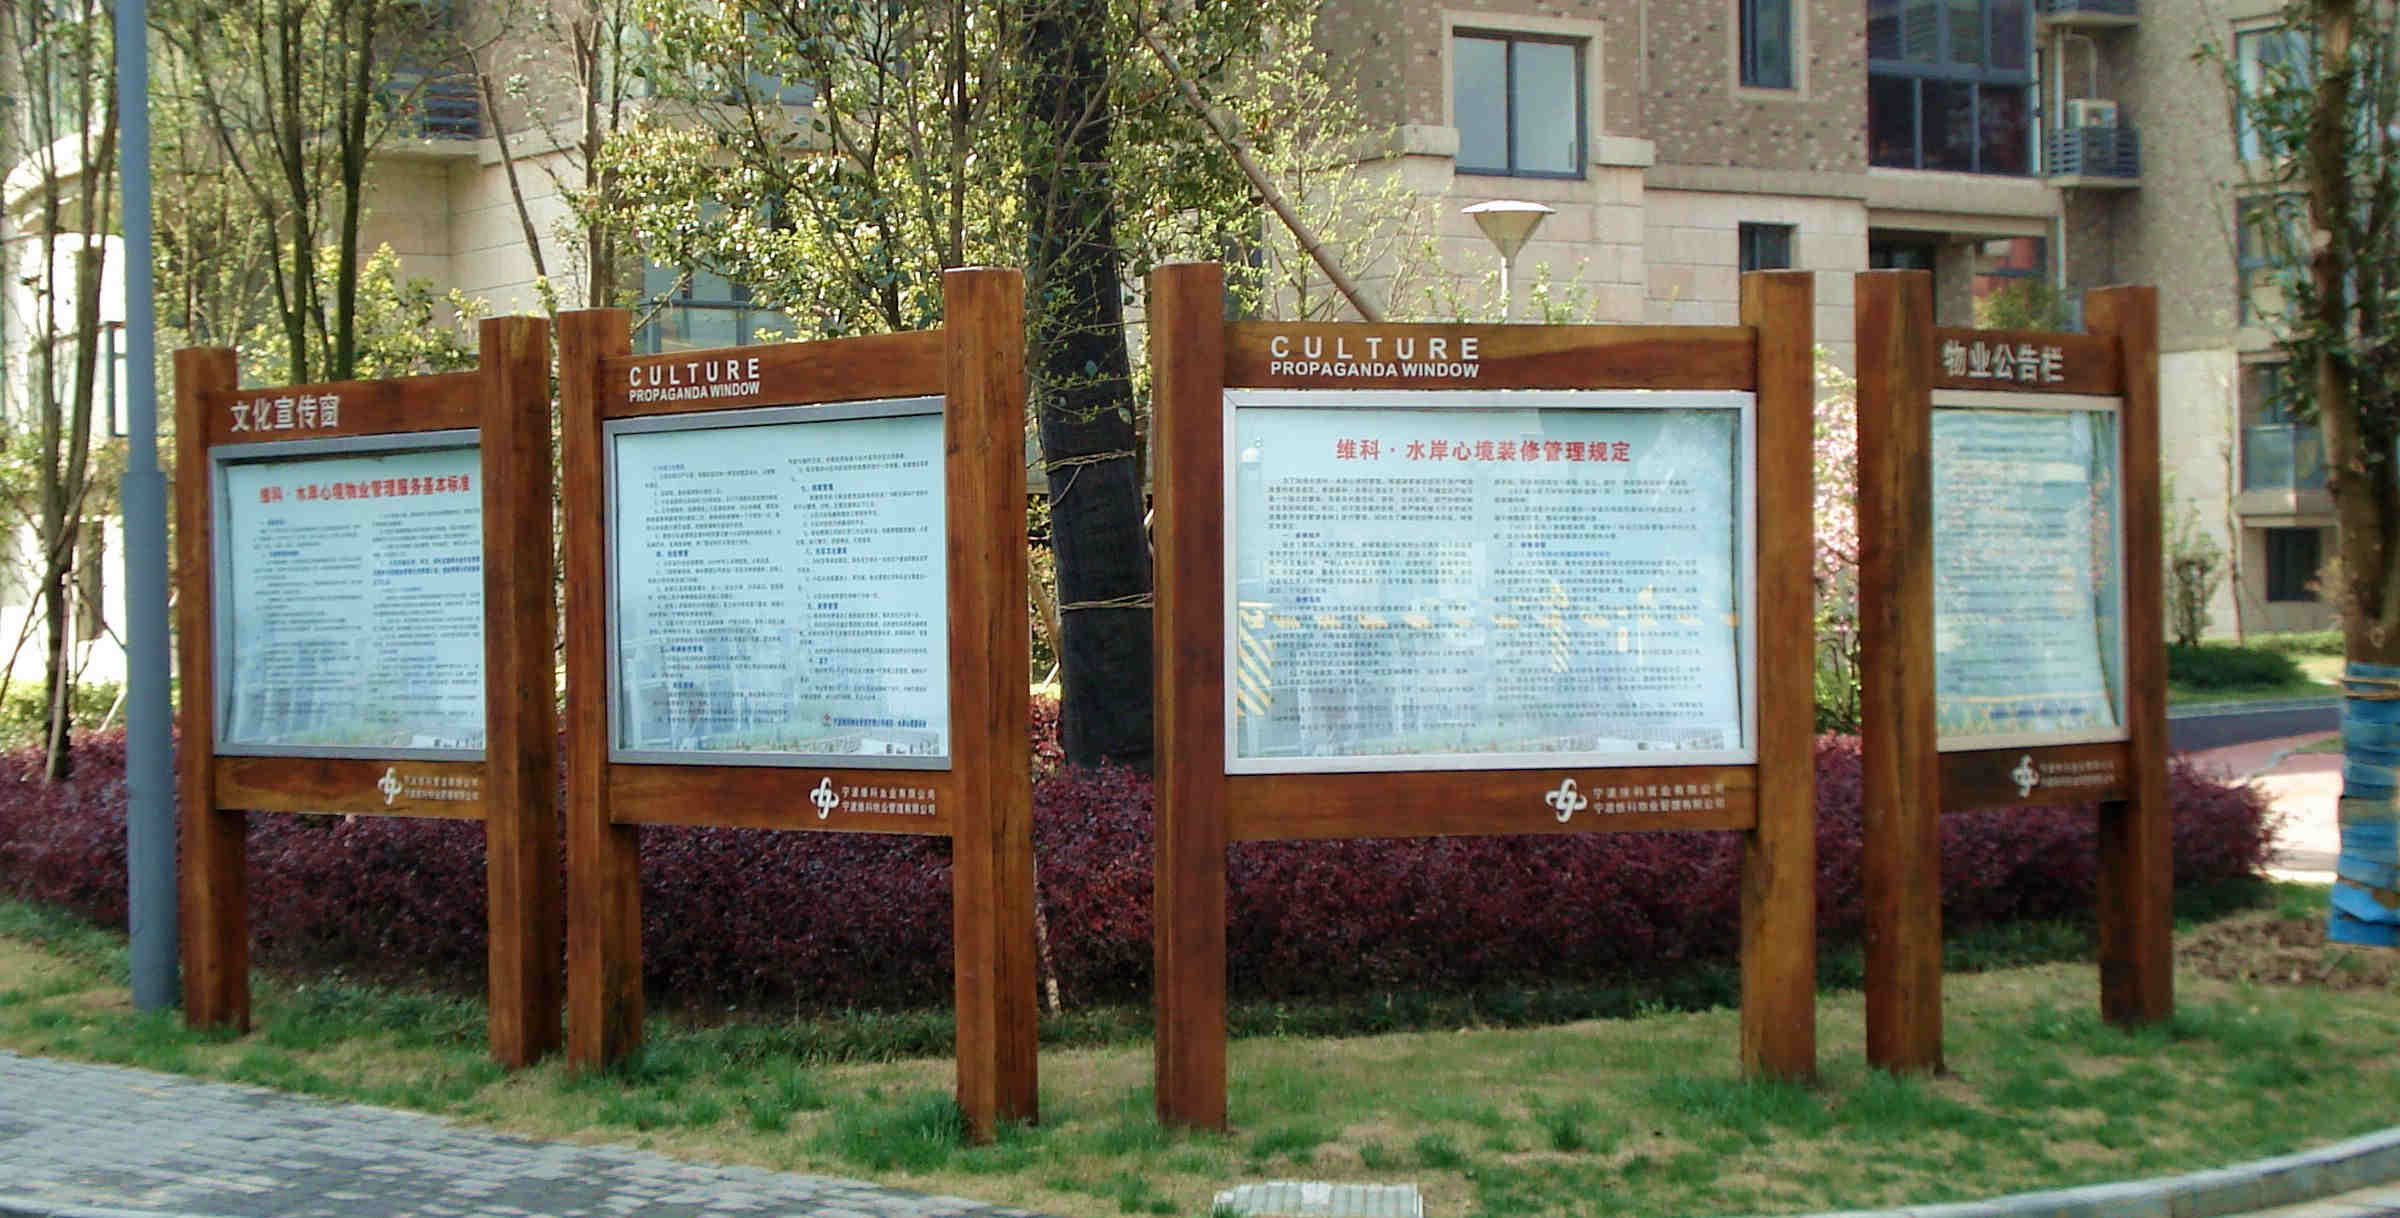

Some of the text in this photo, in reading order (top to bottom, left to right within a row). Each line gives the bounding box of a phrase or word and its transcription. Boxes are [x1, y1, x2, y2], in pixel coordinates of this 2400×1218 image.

[1271, 335, 1480, 360] CULTURE
[1942, 339, 2066, 382] 物业公告栏
[628, 357, 761, 387] CULTURE
[1271, 360, 1480, 378] PROPAGANDA WINDOW
[628, 380, 761, 403] PROPAGANDA WINDOW
[230, 393, 340, 433] 文化宣传窗
